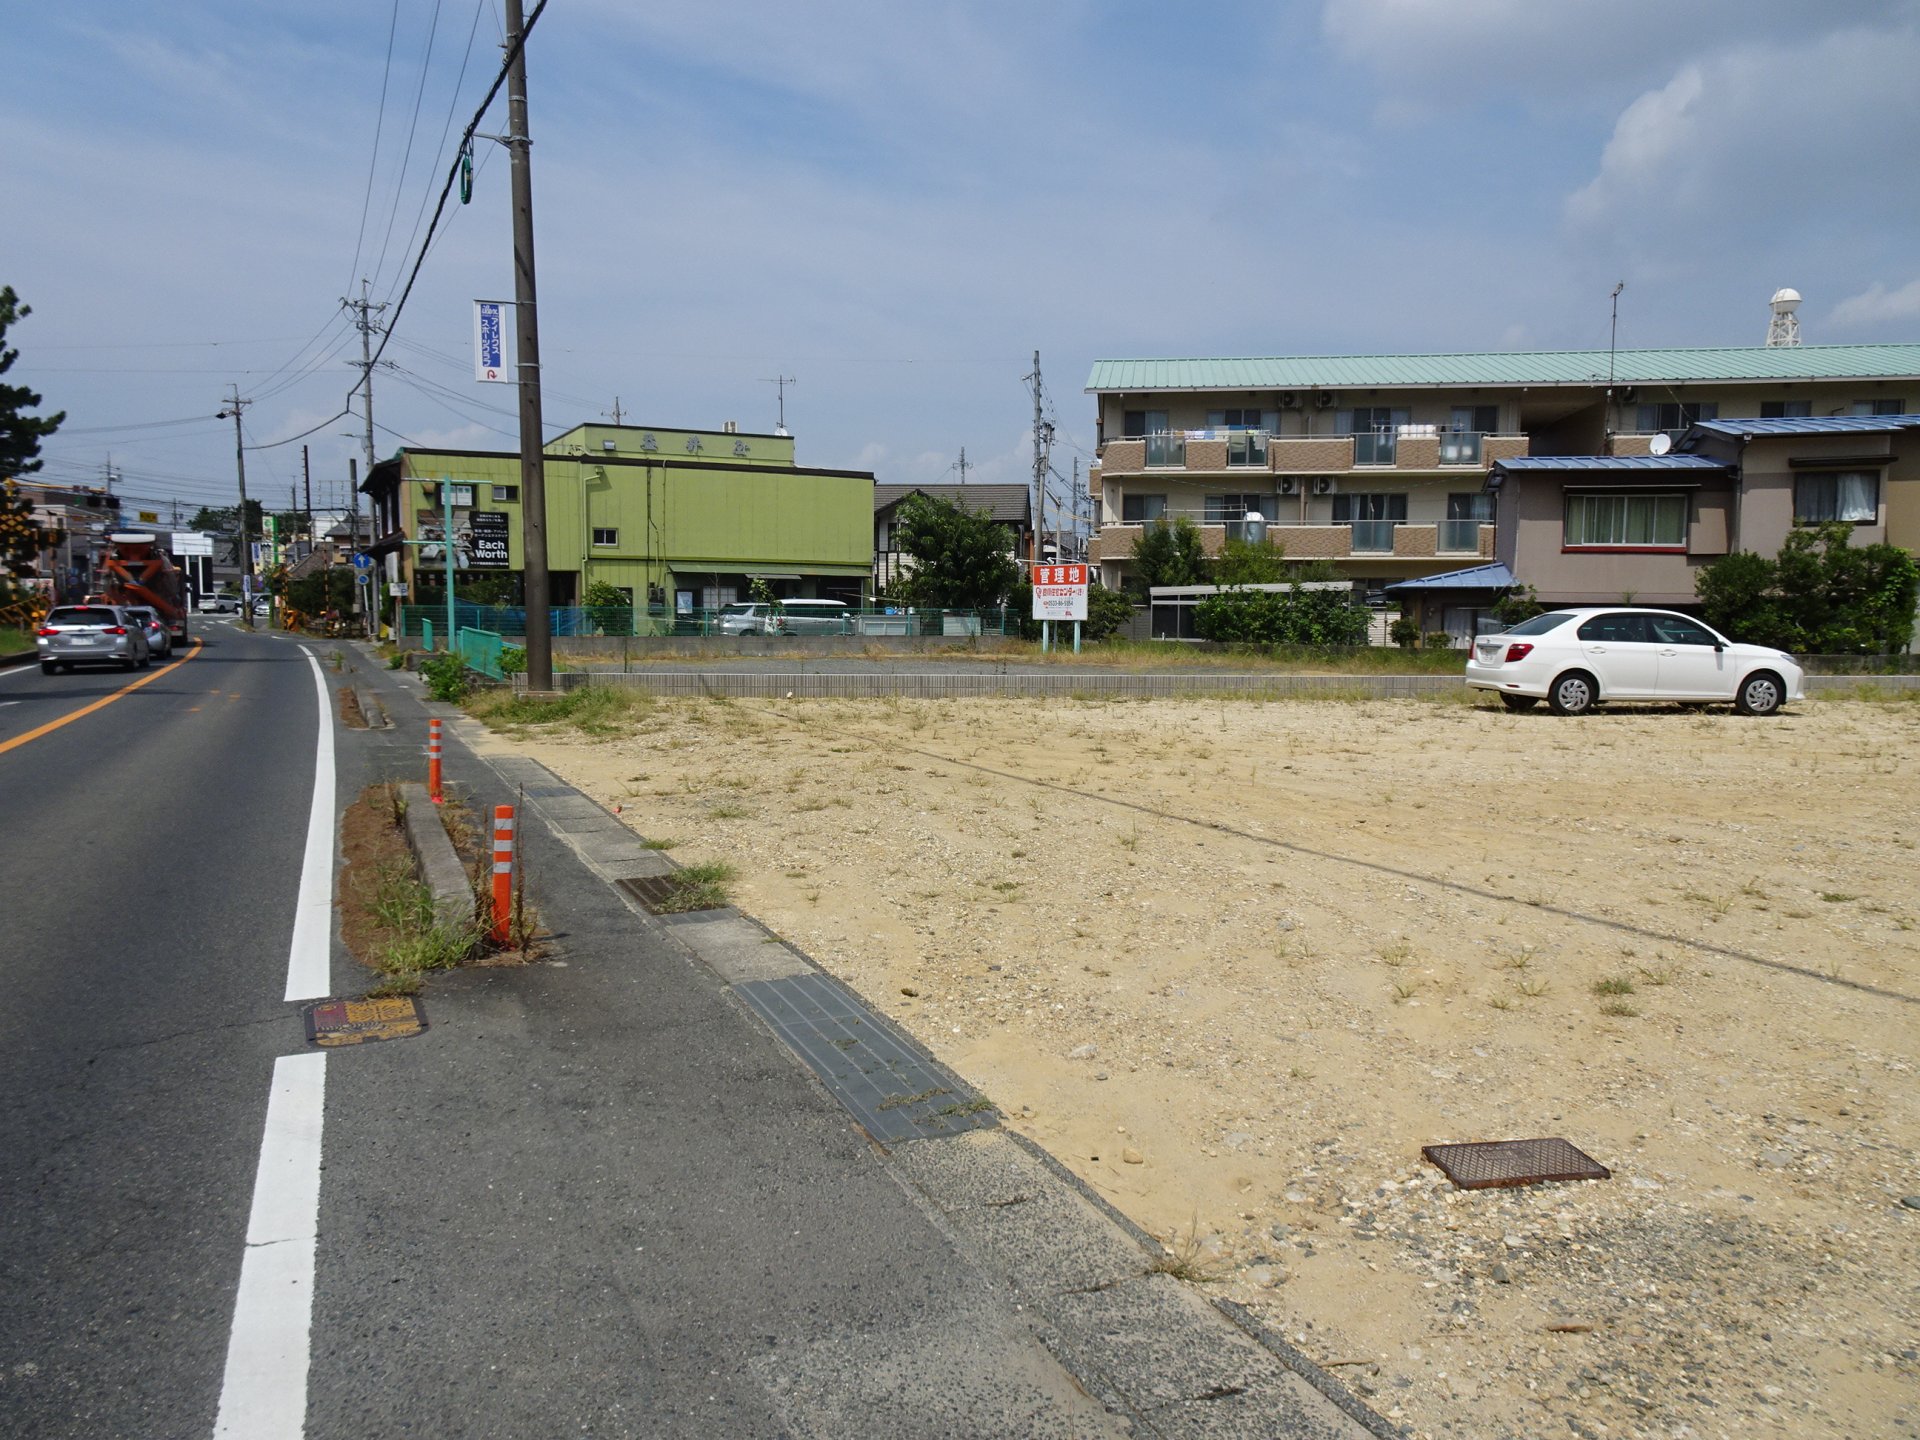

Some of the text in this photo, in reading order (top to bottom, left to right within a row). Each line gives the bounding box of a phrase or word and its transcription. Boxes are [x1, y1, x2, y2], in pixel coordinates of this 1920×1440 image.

[482, 319, 491, 367] スポーツクラブ
[491, 317, 500, 354] アイレクス
[478, 540, 504, 549] Each
[475, 550, 507, 559] Worth
[1040, 567, 1080, 584] 管理地
